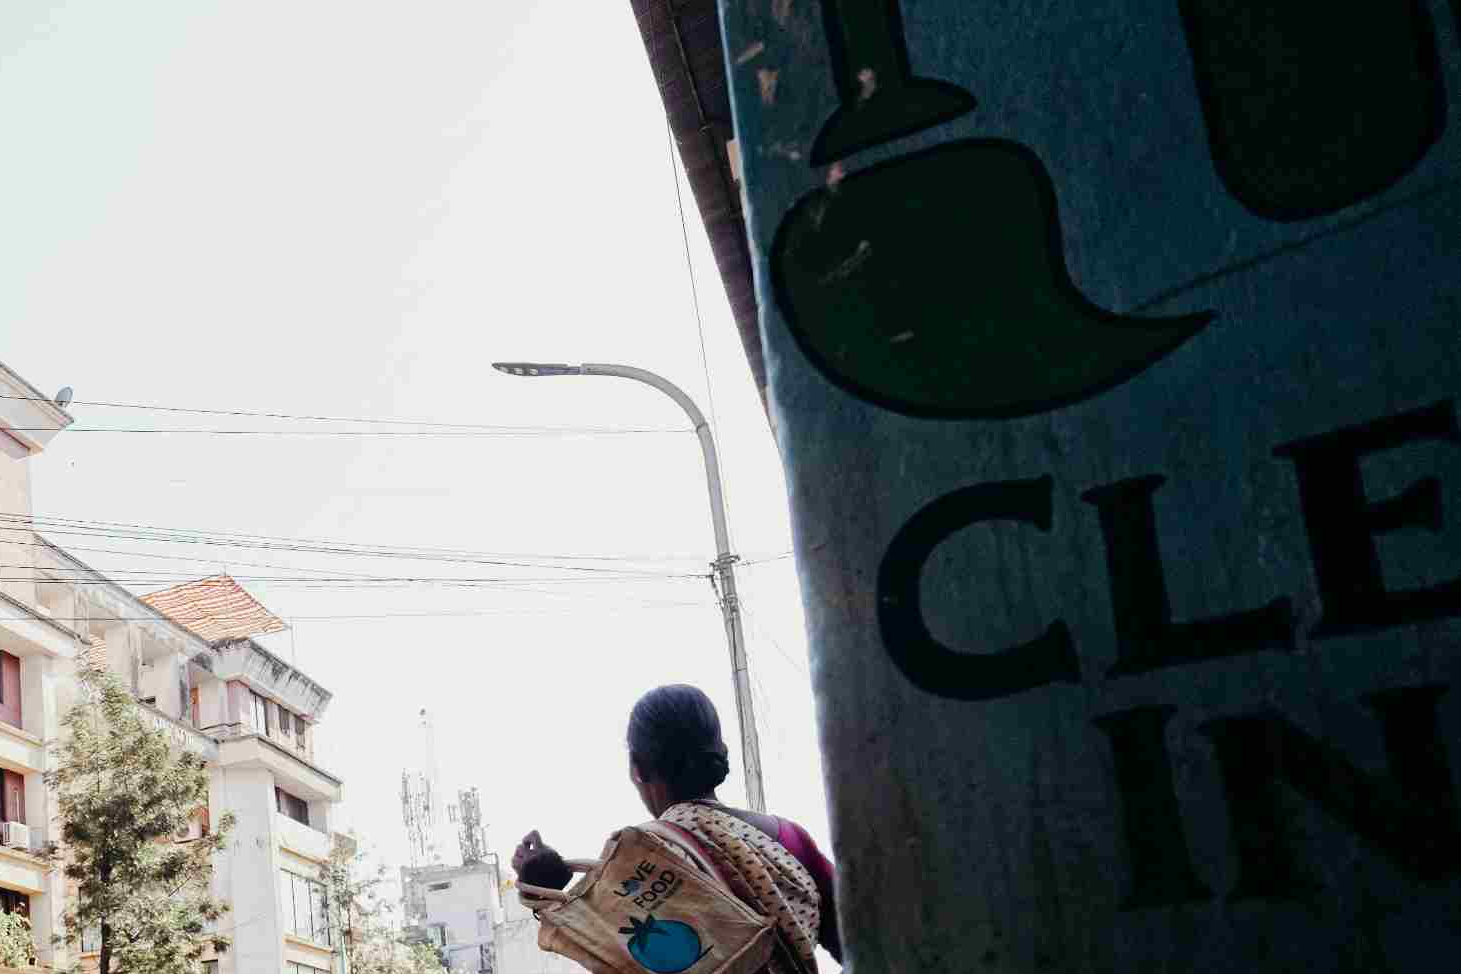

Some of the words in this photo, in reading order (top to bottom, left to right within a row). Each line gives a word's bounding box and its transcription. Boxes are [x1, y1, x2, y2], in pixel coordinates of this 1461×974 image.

[877, 396, 1461, 700] CLE
[634, 870, 674, 908] FOOD
[1093, 684, 1461, 910] IN
